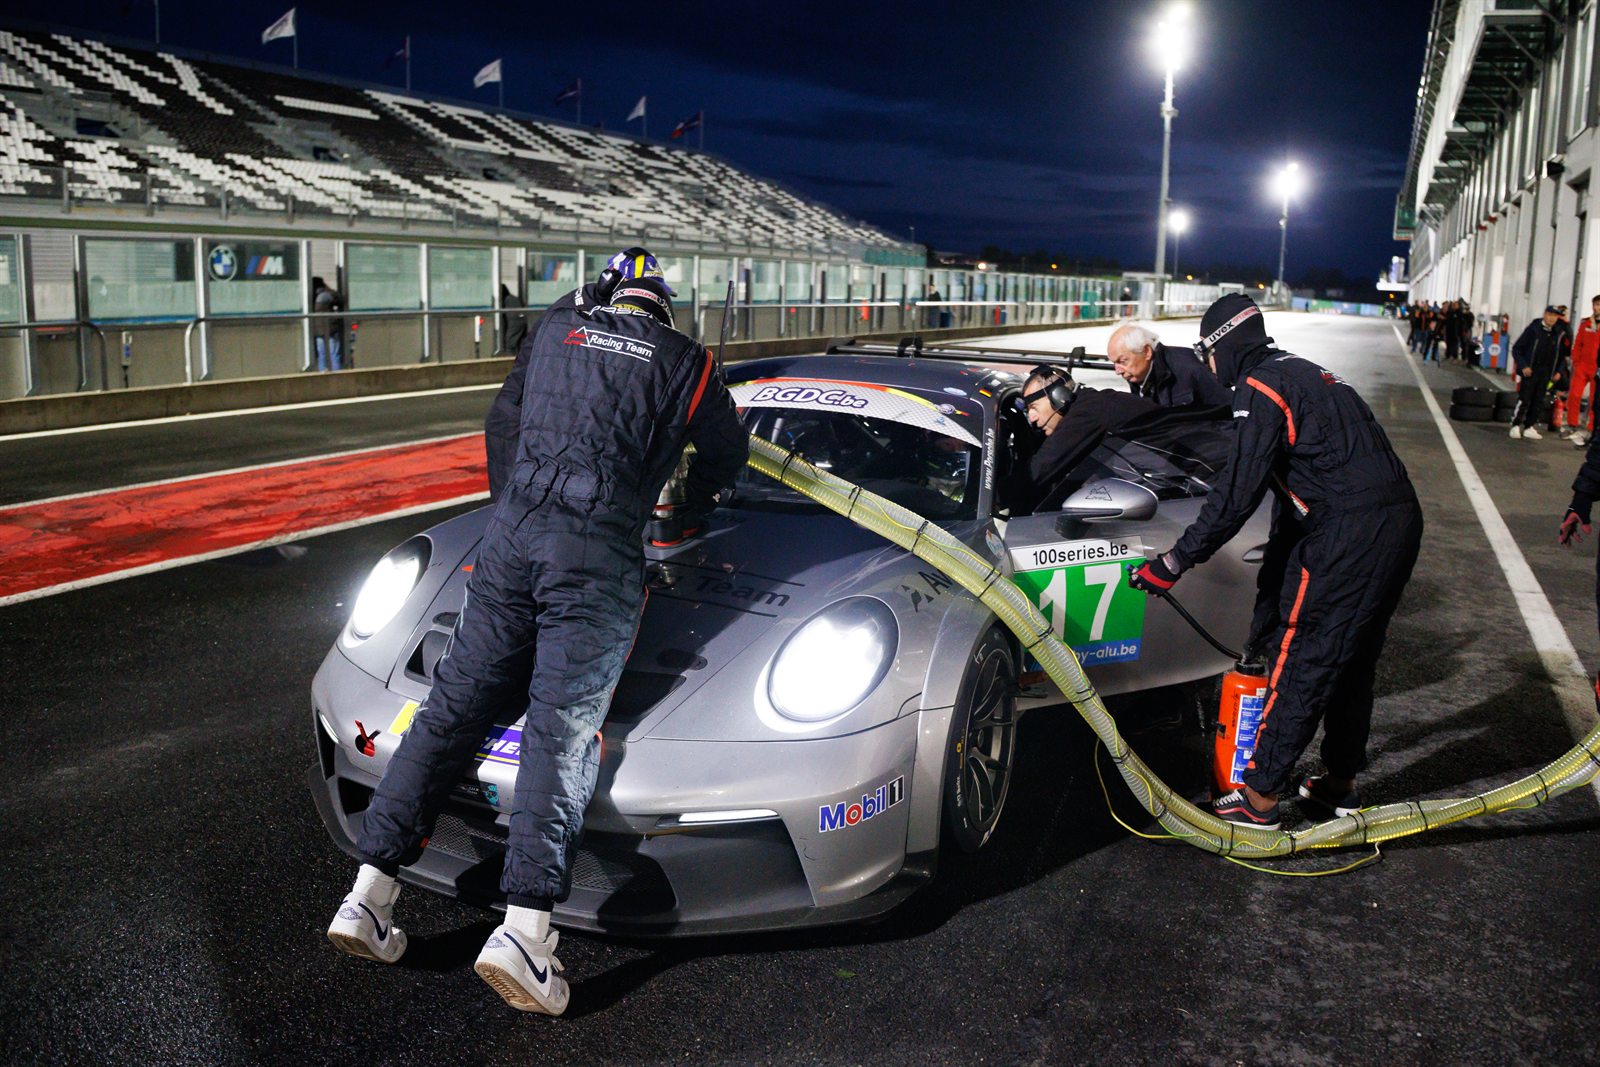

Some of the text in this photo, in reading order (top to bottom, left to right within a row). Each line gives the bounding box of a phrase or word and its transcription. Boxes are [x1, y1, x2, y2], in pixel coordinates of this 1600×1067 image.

[1208, 320, 1235, 343] uvex
[589, 334, 622, 351] Racing
[626, 342, 653, 358] Team
[751, 387, 868, 408] BGDC.be
[1033, 542, 1128, 566] 100series.be
[696, 575, 790, 607] Team
[1039, 563, 1122, 641] 17
[819, 785, 887, 833] Mobil
